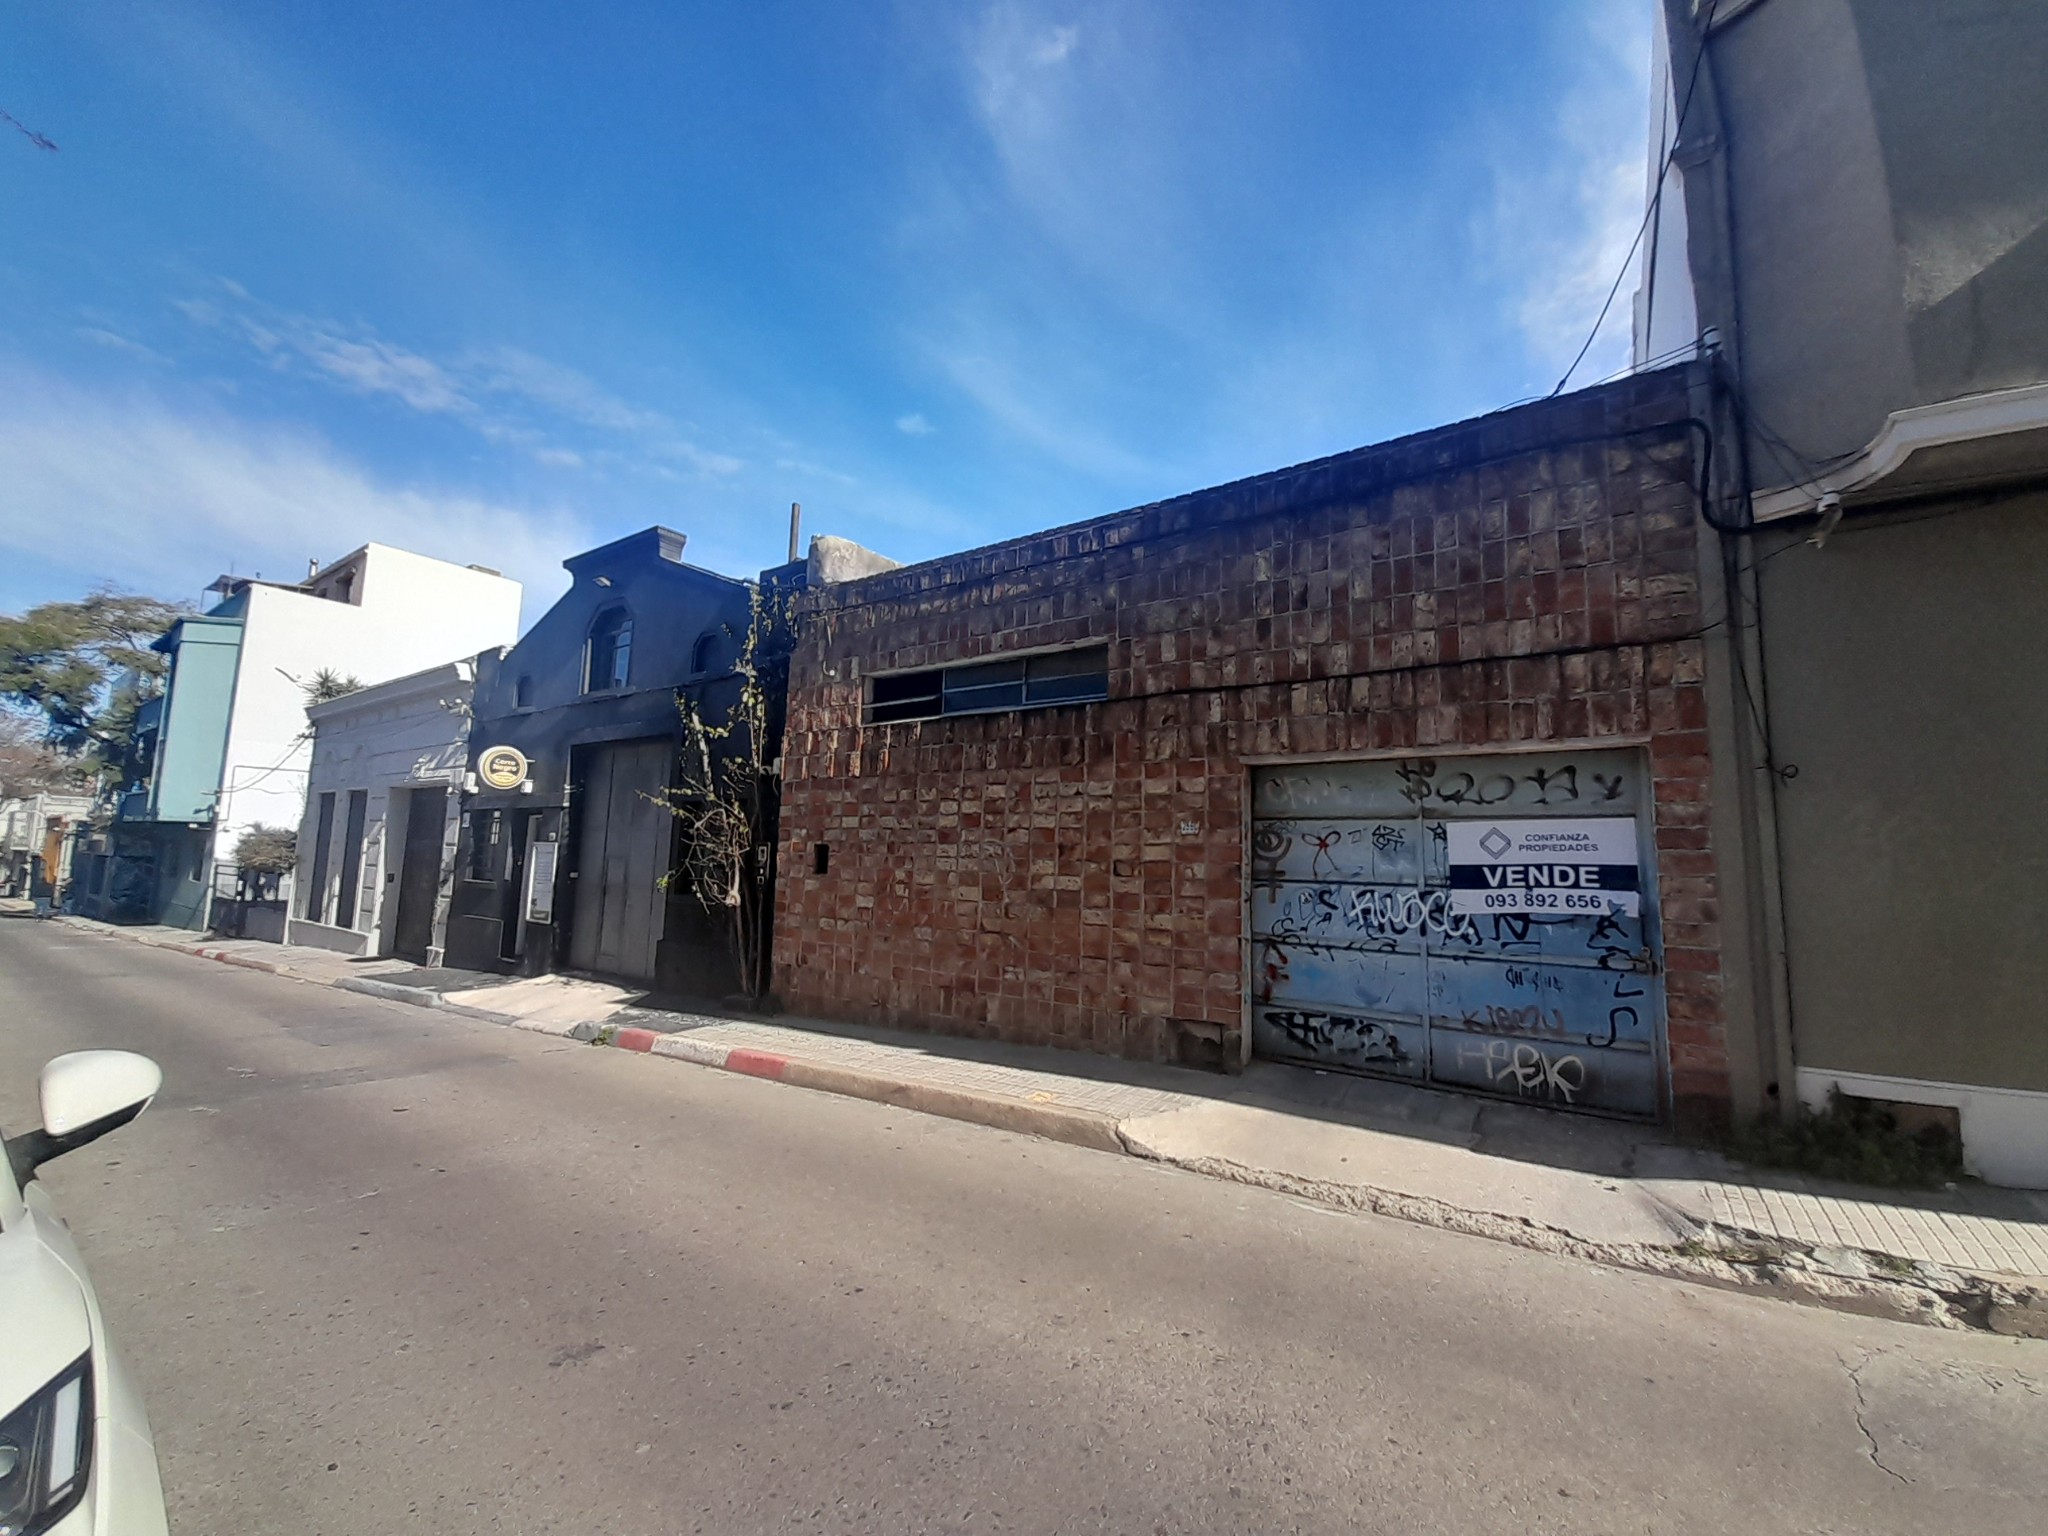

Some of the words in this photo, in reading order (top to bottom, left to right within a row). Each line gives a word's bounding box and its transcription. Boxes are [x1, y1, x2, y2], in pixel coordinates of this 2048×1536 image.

[1525, 833, 1590, 842] CONFIANZA
[1518, 843, 1599, 852] PROPIEDADES
[1482, 865, 1601, 888] VENDE
[1485, 894, 1517, 908] 093
[1524, 894, 1558, 908] 892
[1566, 895, 1602, 909] 656
